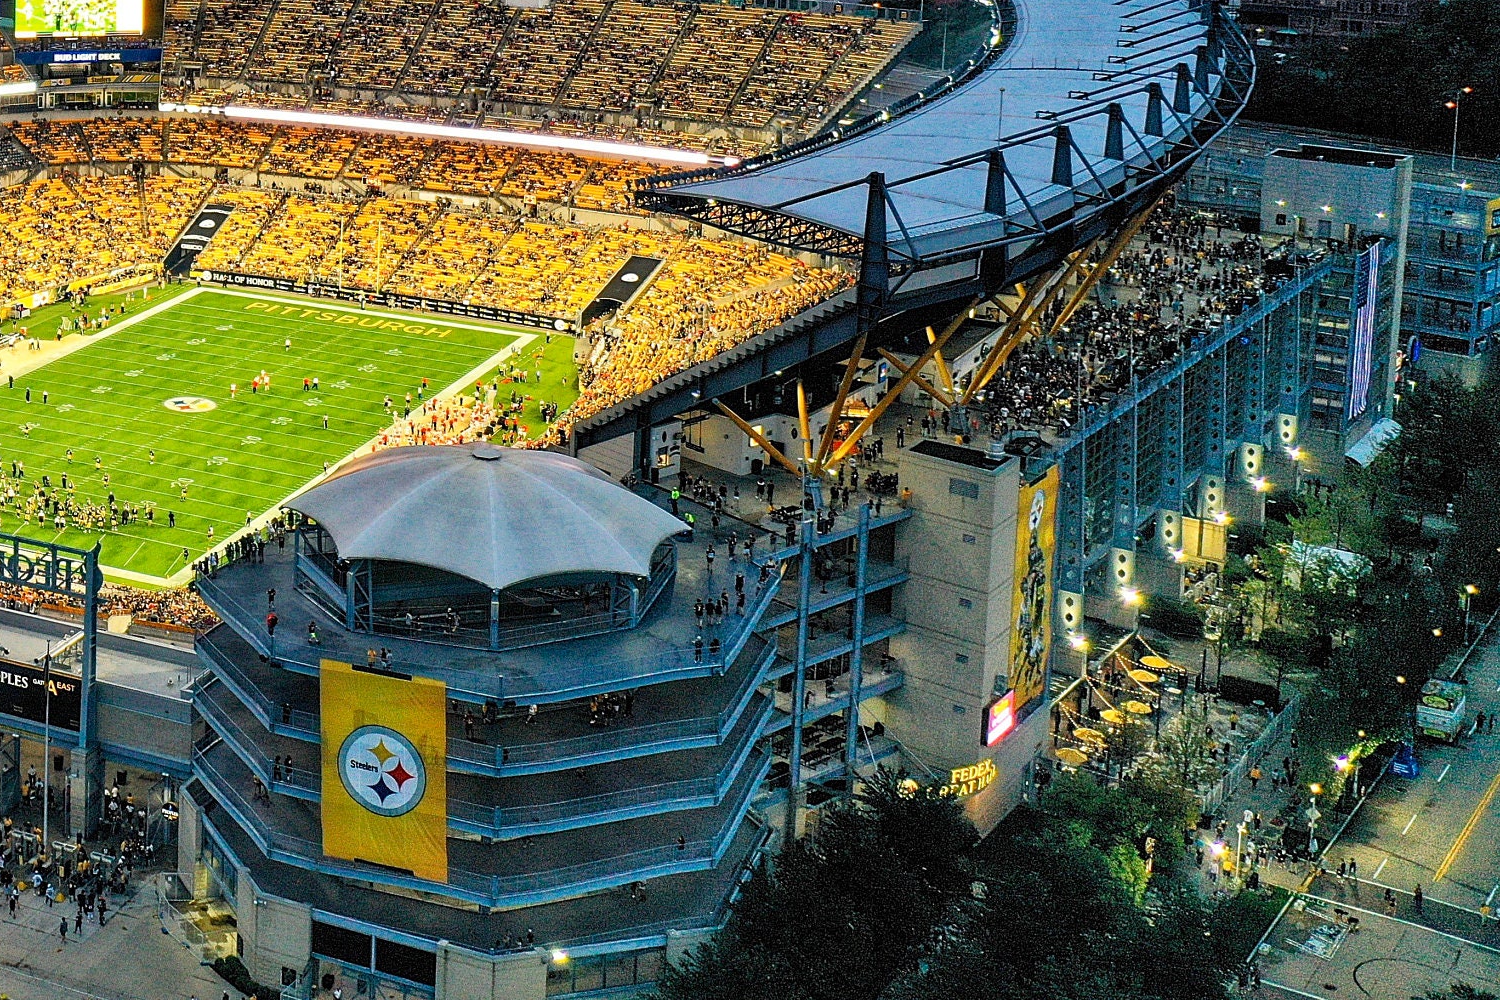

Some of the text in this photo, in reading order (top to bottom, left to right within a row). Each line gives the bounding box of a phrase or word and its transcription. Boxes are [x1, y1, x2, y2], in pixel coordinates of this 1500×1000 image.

[54, 52, 121, 62] BUD LIGHT DECK
[234, 275, 245, 283] OF
[246, 276, 274, 287] HONOR
[244, 302, 452, 338] PITTSBURGH
[56, 681, 75, 692] EAST
[350, 759, 379, 773] Steelers
[951, 759, 993, 783] FEDEX
